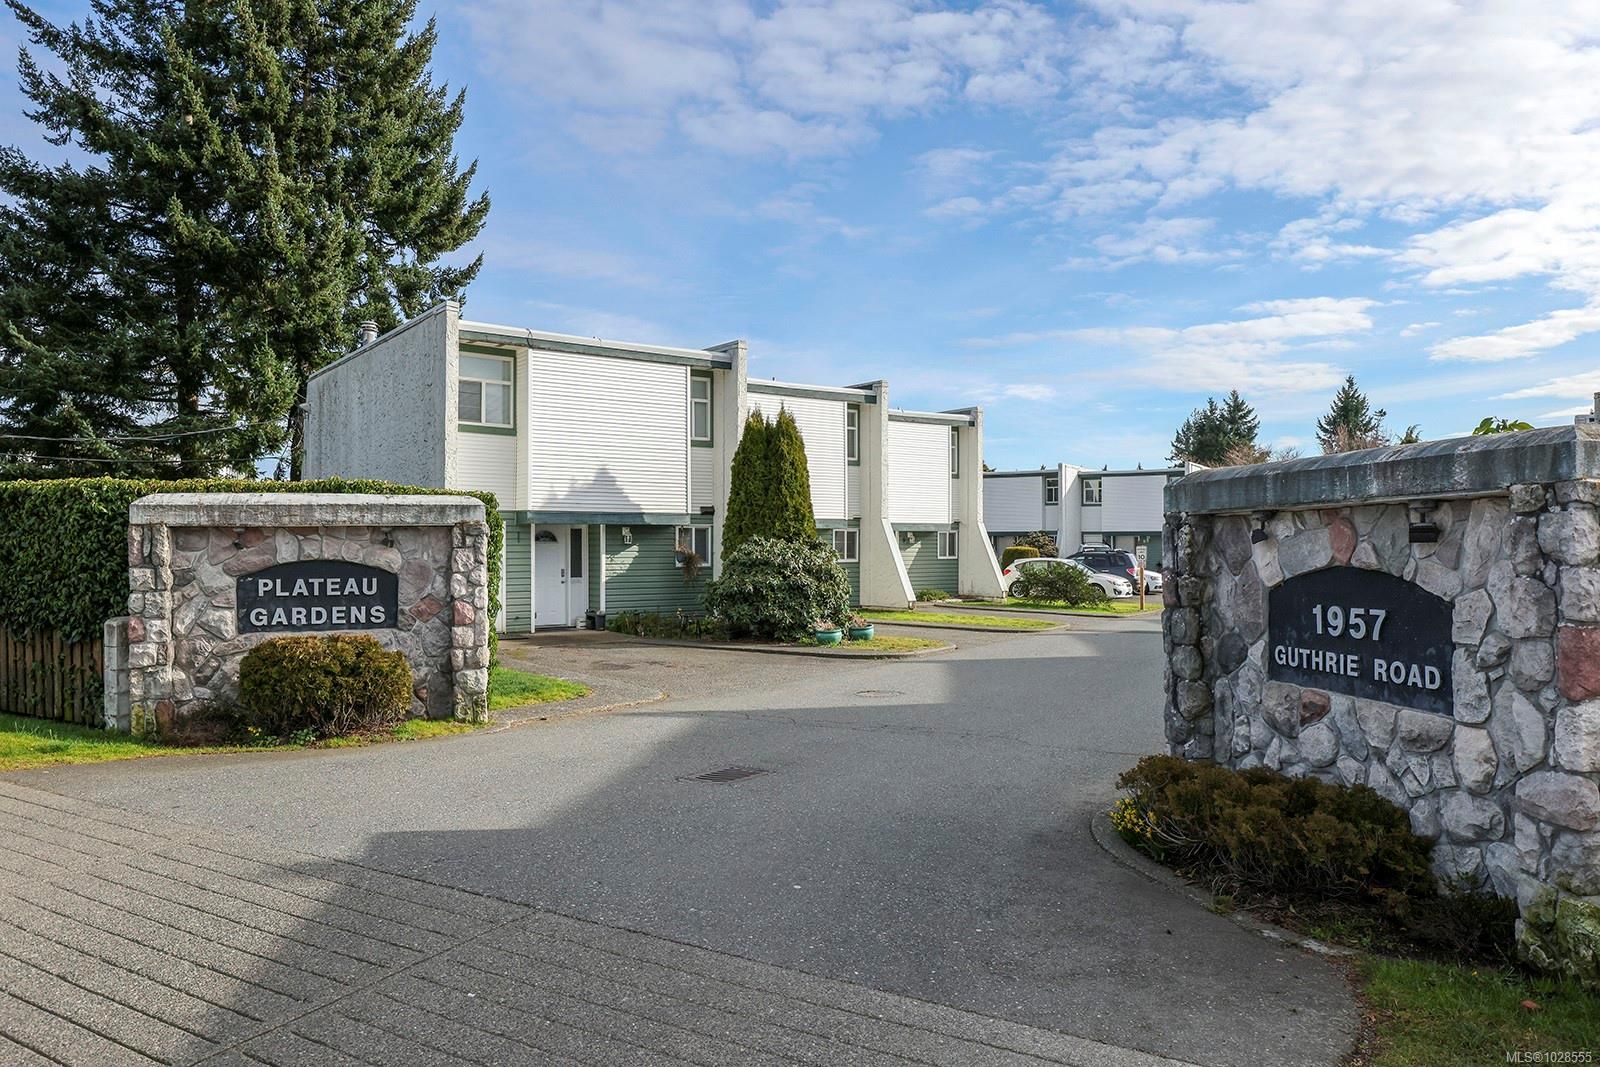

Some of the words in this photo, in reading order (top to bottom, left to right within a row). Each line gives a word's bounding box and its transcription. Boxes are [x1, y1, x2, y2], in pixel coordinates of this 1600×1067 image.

[258, 577, 378, 597] PLATEAU
[250, 605, 386, 626] GARDENS
[1312, 604, 1387, 641] 1957
[1274, 645, 1360, 678] GUTHRIE
[1373, 658, 1441, 690] ROAD
